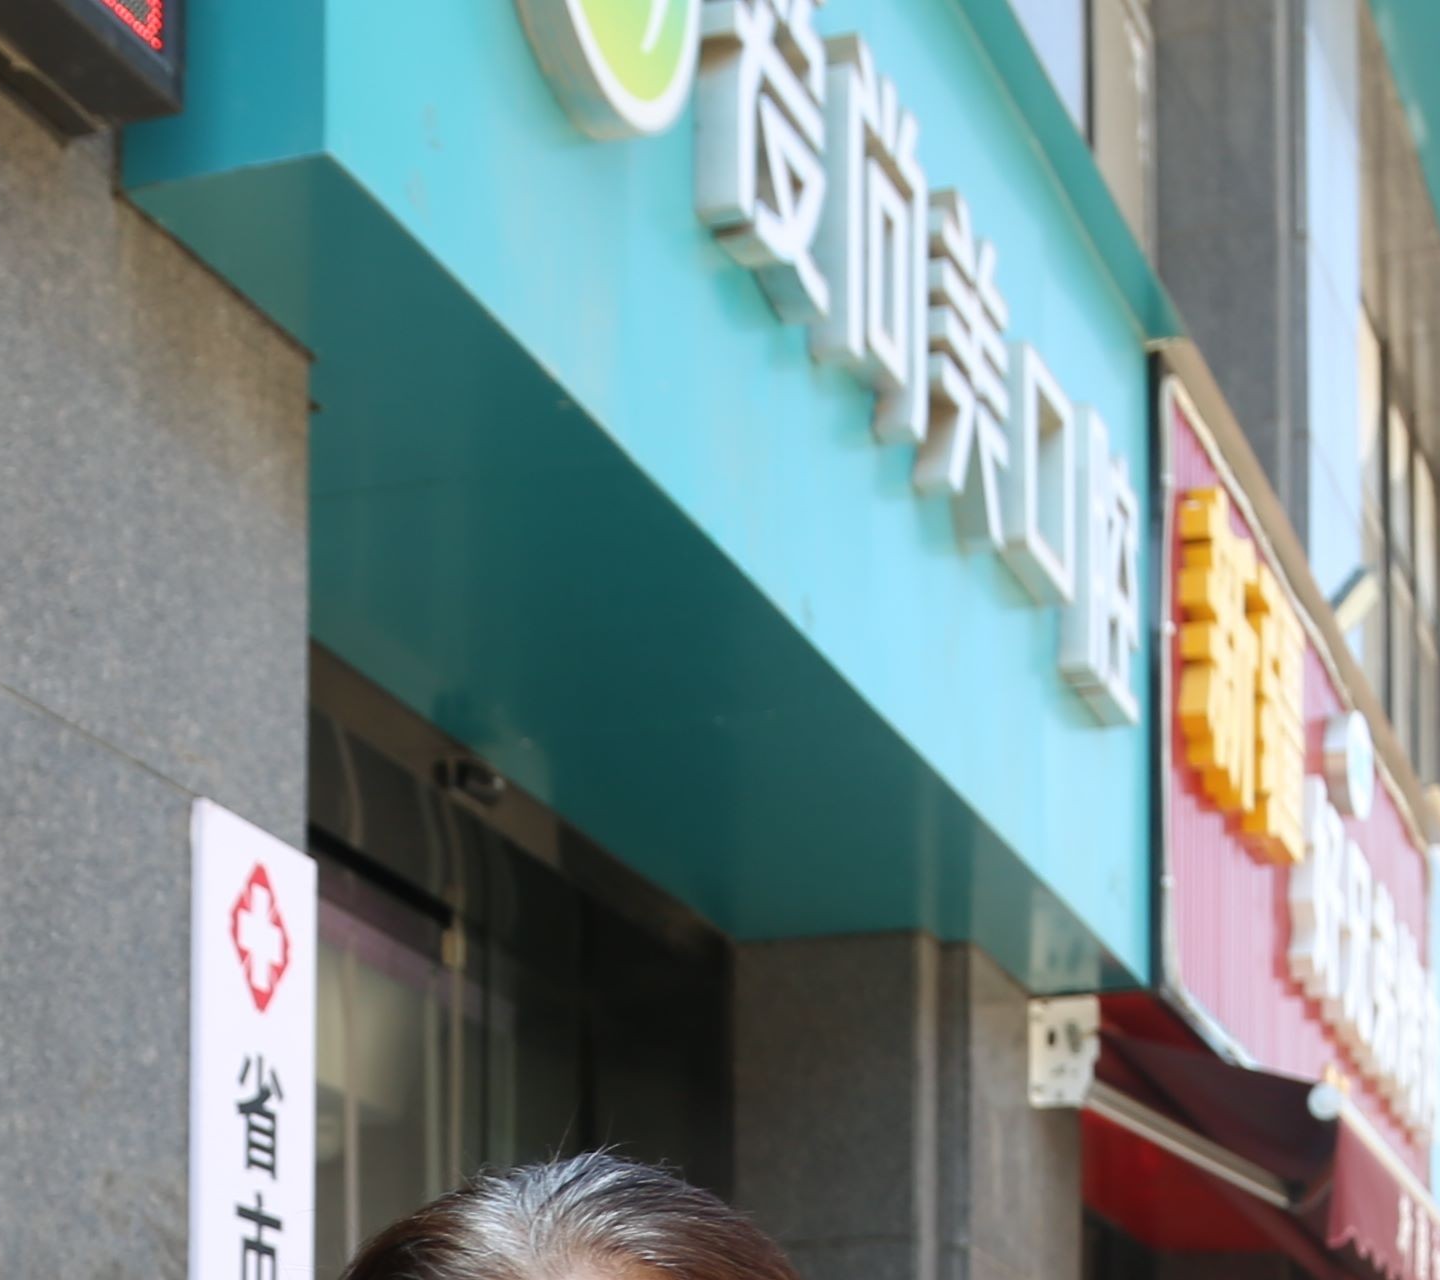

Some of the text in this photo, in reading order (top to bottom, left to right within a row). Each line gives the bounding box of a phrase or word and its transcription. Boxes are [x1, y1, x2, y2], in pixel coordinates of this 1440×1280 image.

[712, 0, 1141, 726] 爱尚美口腔
